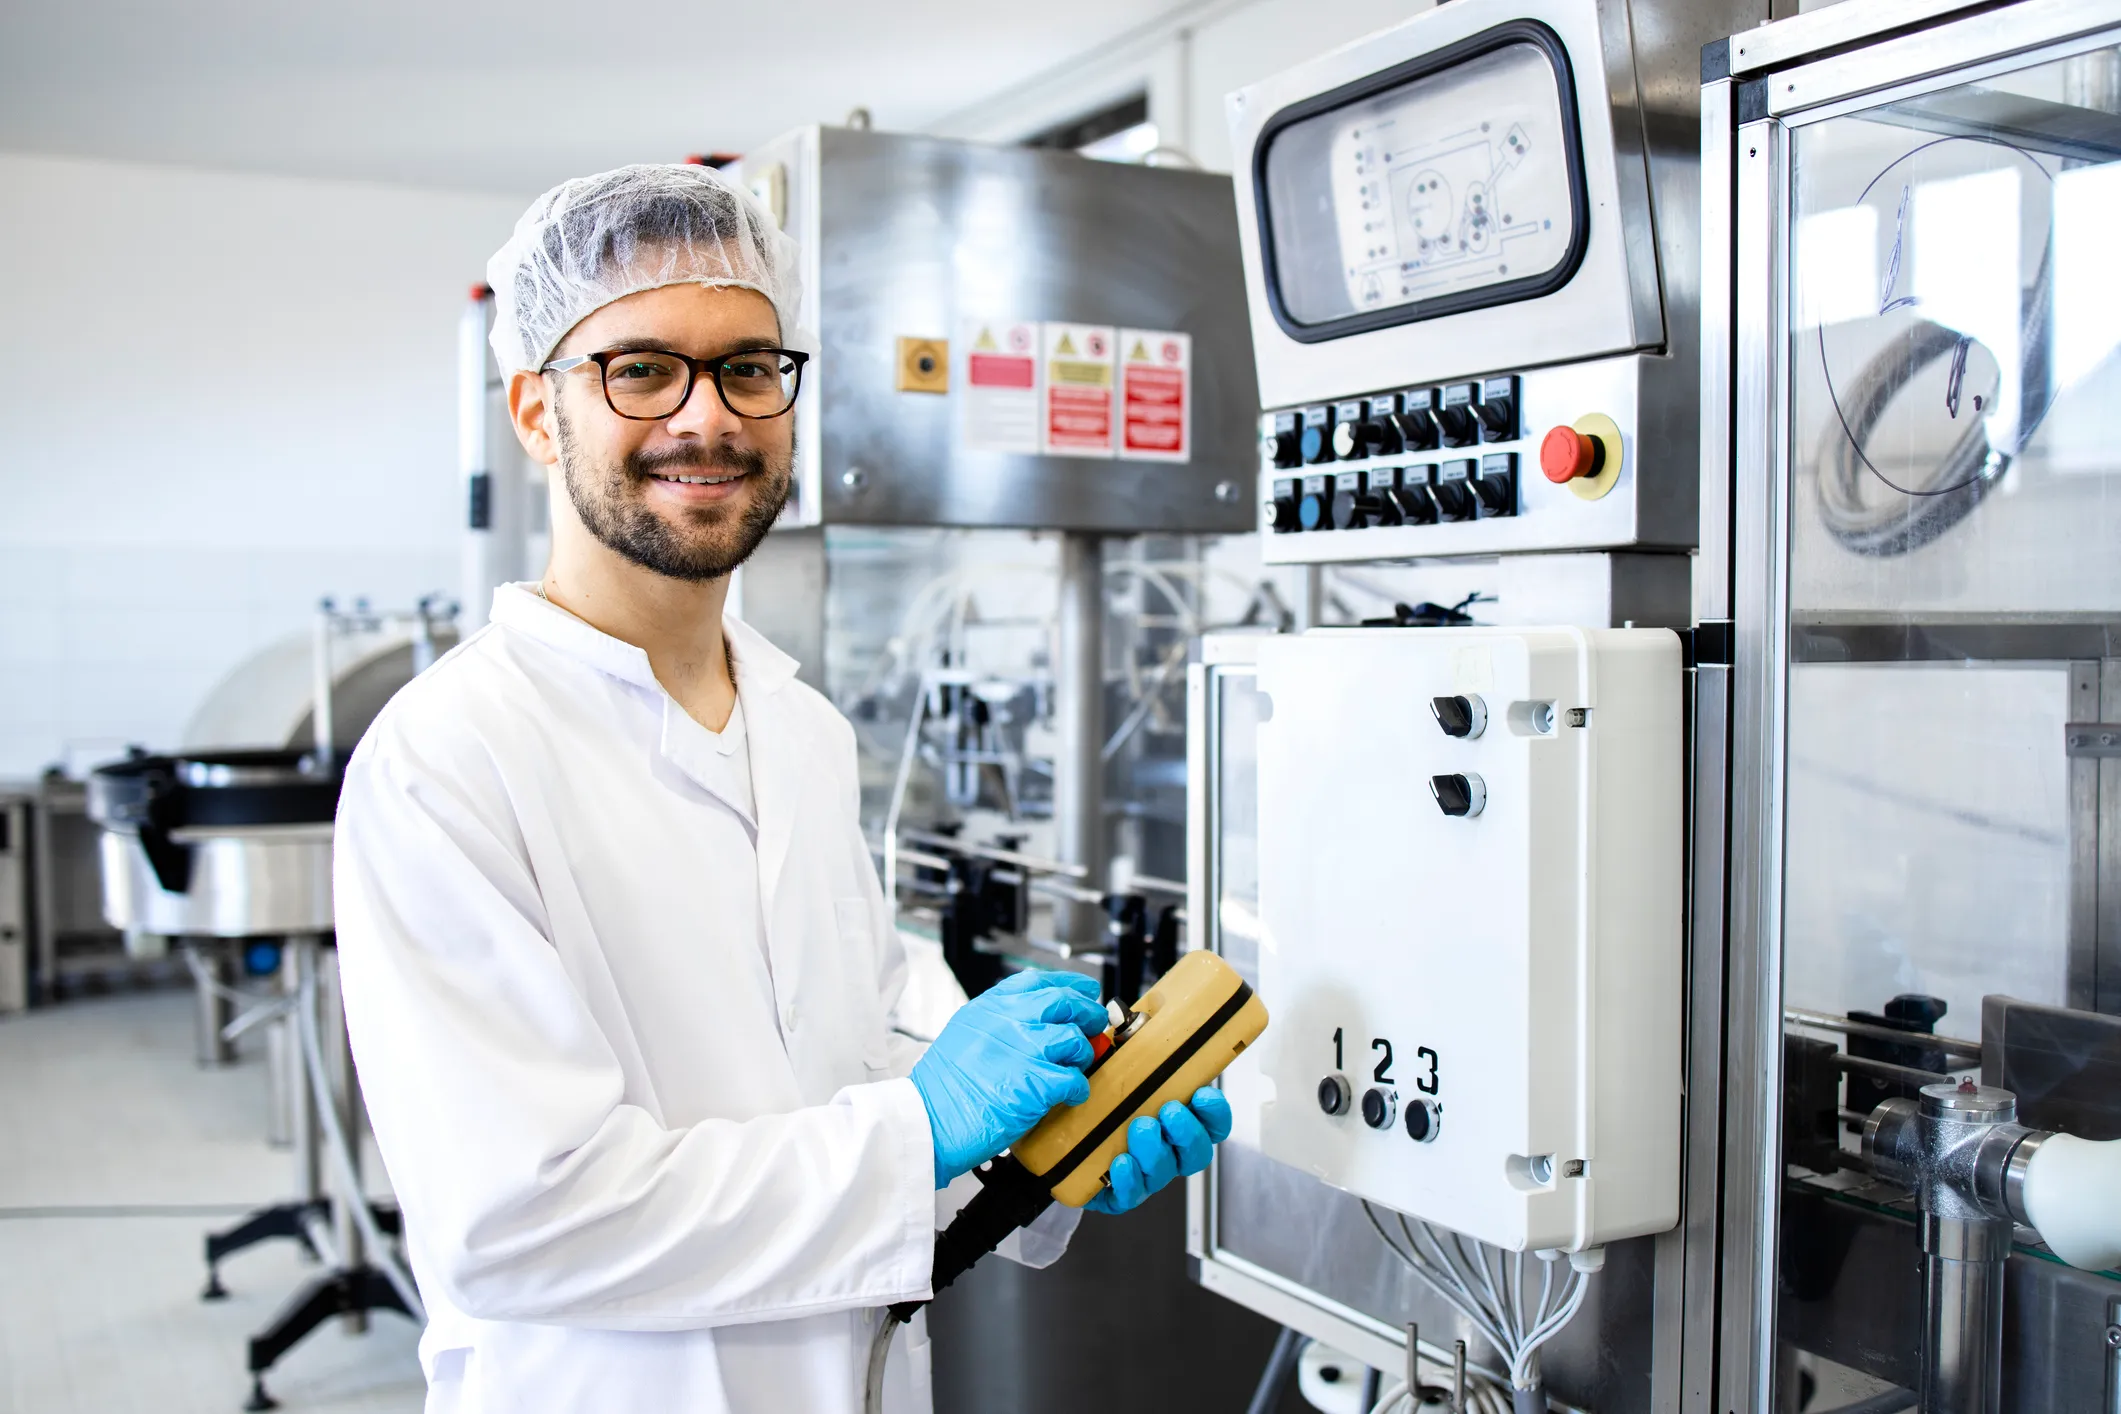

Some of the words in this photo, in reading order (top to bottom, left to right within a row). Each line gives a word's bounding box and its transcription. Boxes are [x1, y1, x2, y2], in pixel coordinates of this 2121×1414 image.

[1333, 1027, 1343, 1071] 1
[1372, 1038, 1395, 1085] 2
[1417, 1046, 1439, 1096] 3
